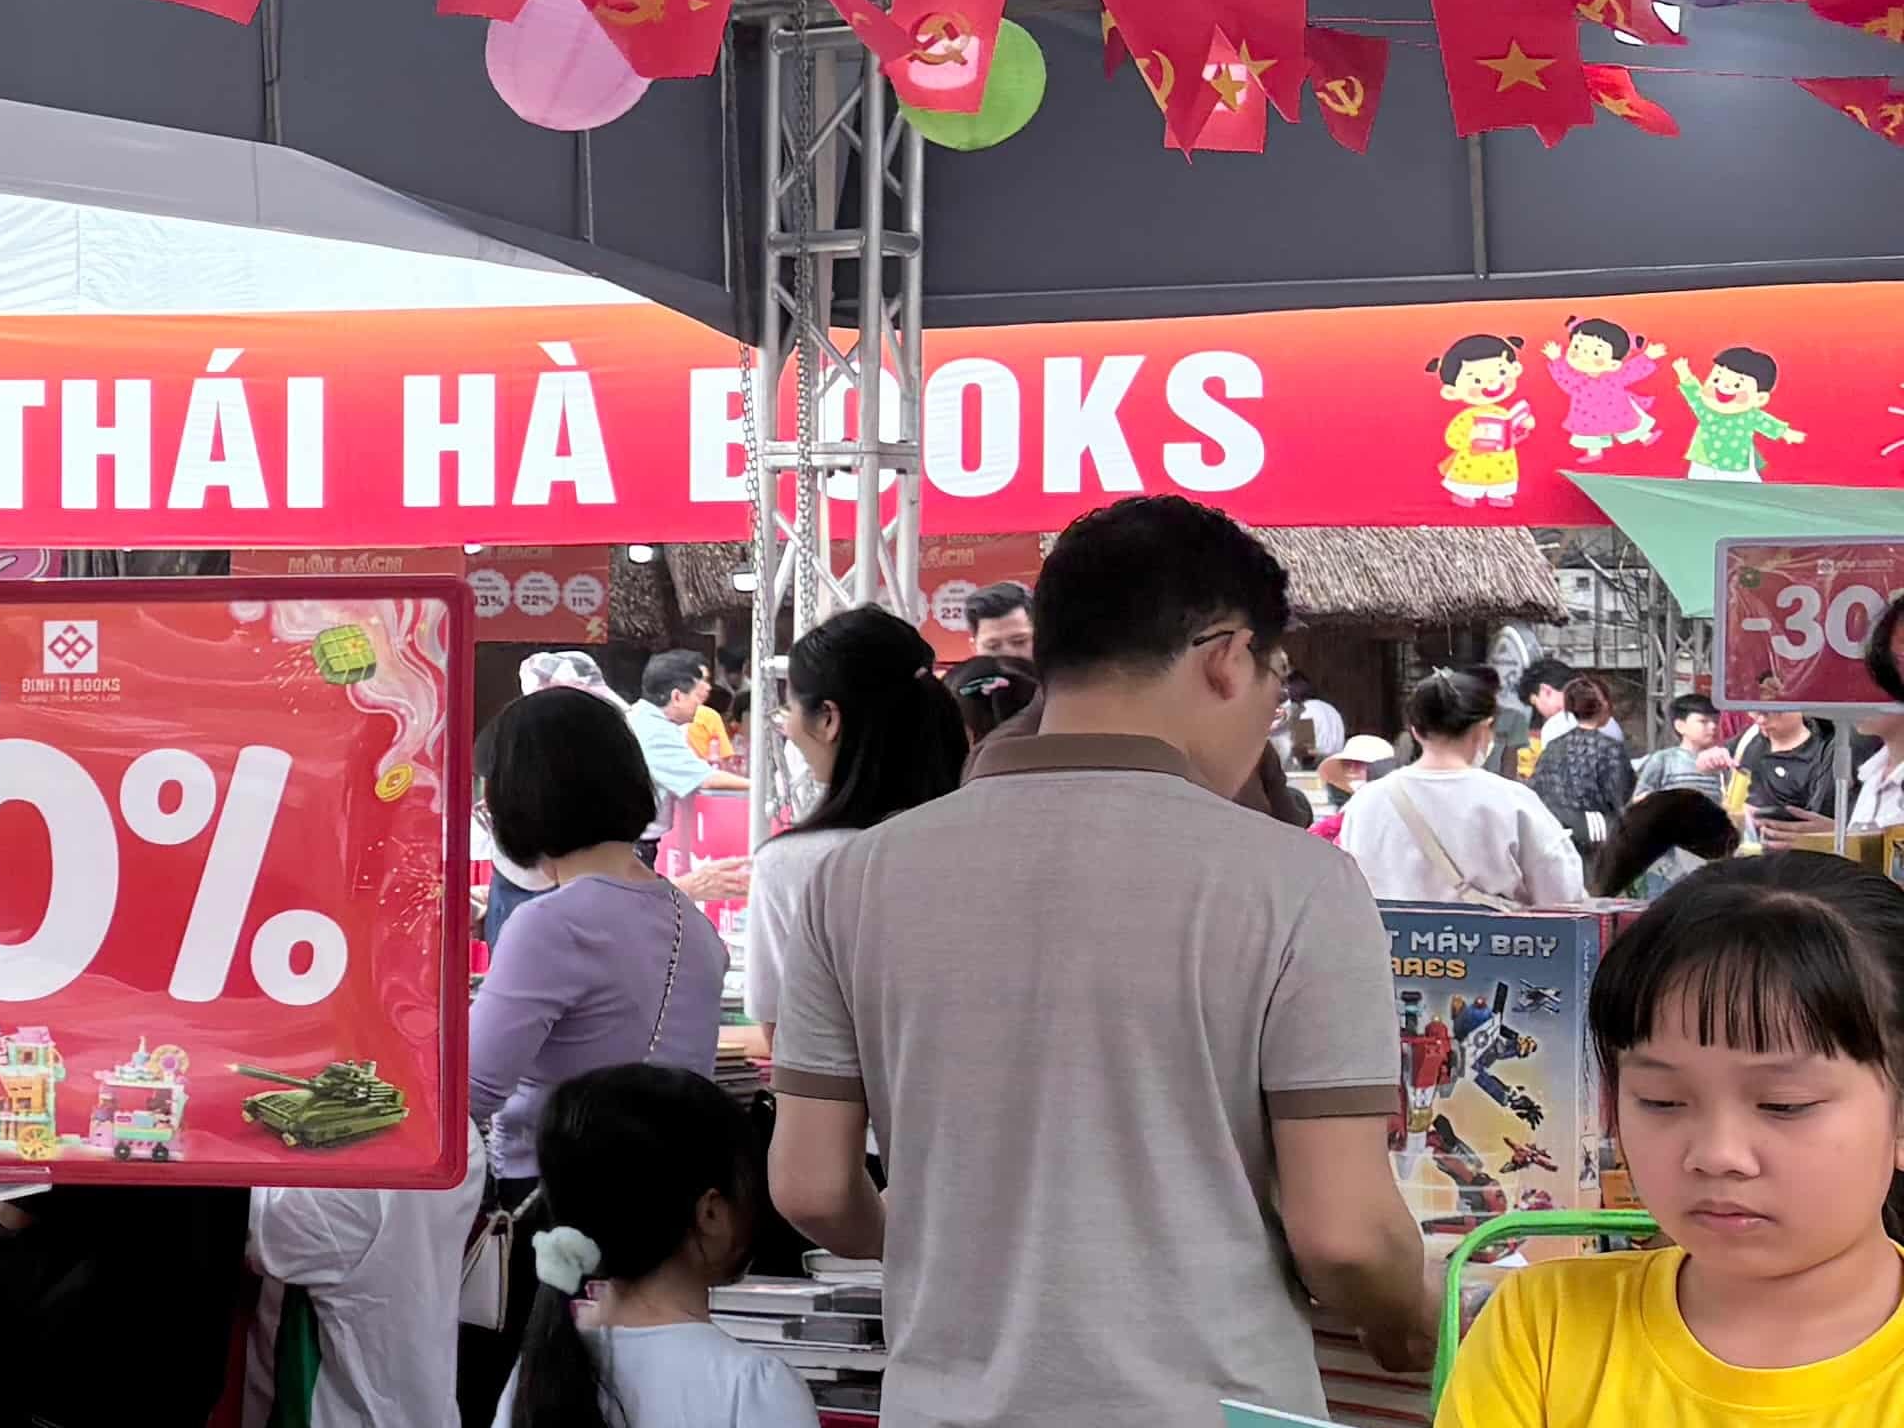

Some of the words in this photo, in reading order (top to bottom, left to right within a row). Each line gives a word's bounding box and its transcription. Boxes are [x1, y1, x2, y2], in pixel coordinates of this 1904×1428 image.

[402, 340, 617, 507] HÀ
[688, 349, 1267, 502] BOOKS
[22, 677, 54, 691] ĐINH
[73, 677, 121, 691] BOOKS
[1411, 926, 1481, 954] MÁY
[1490, 935, 1559, 958] BAY
